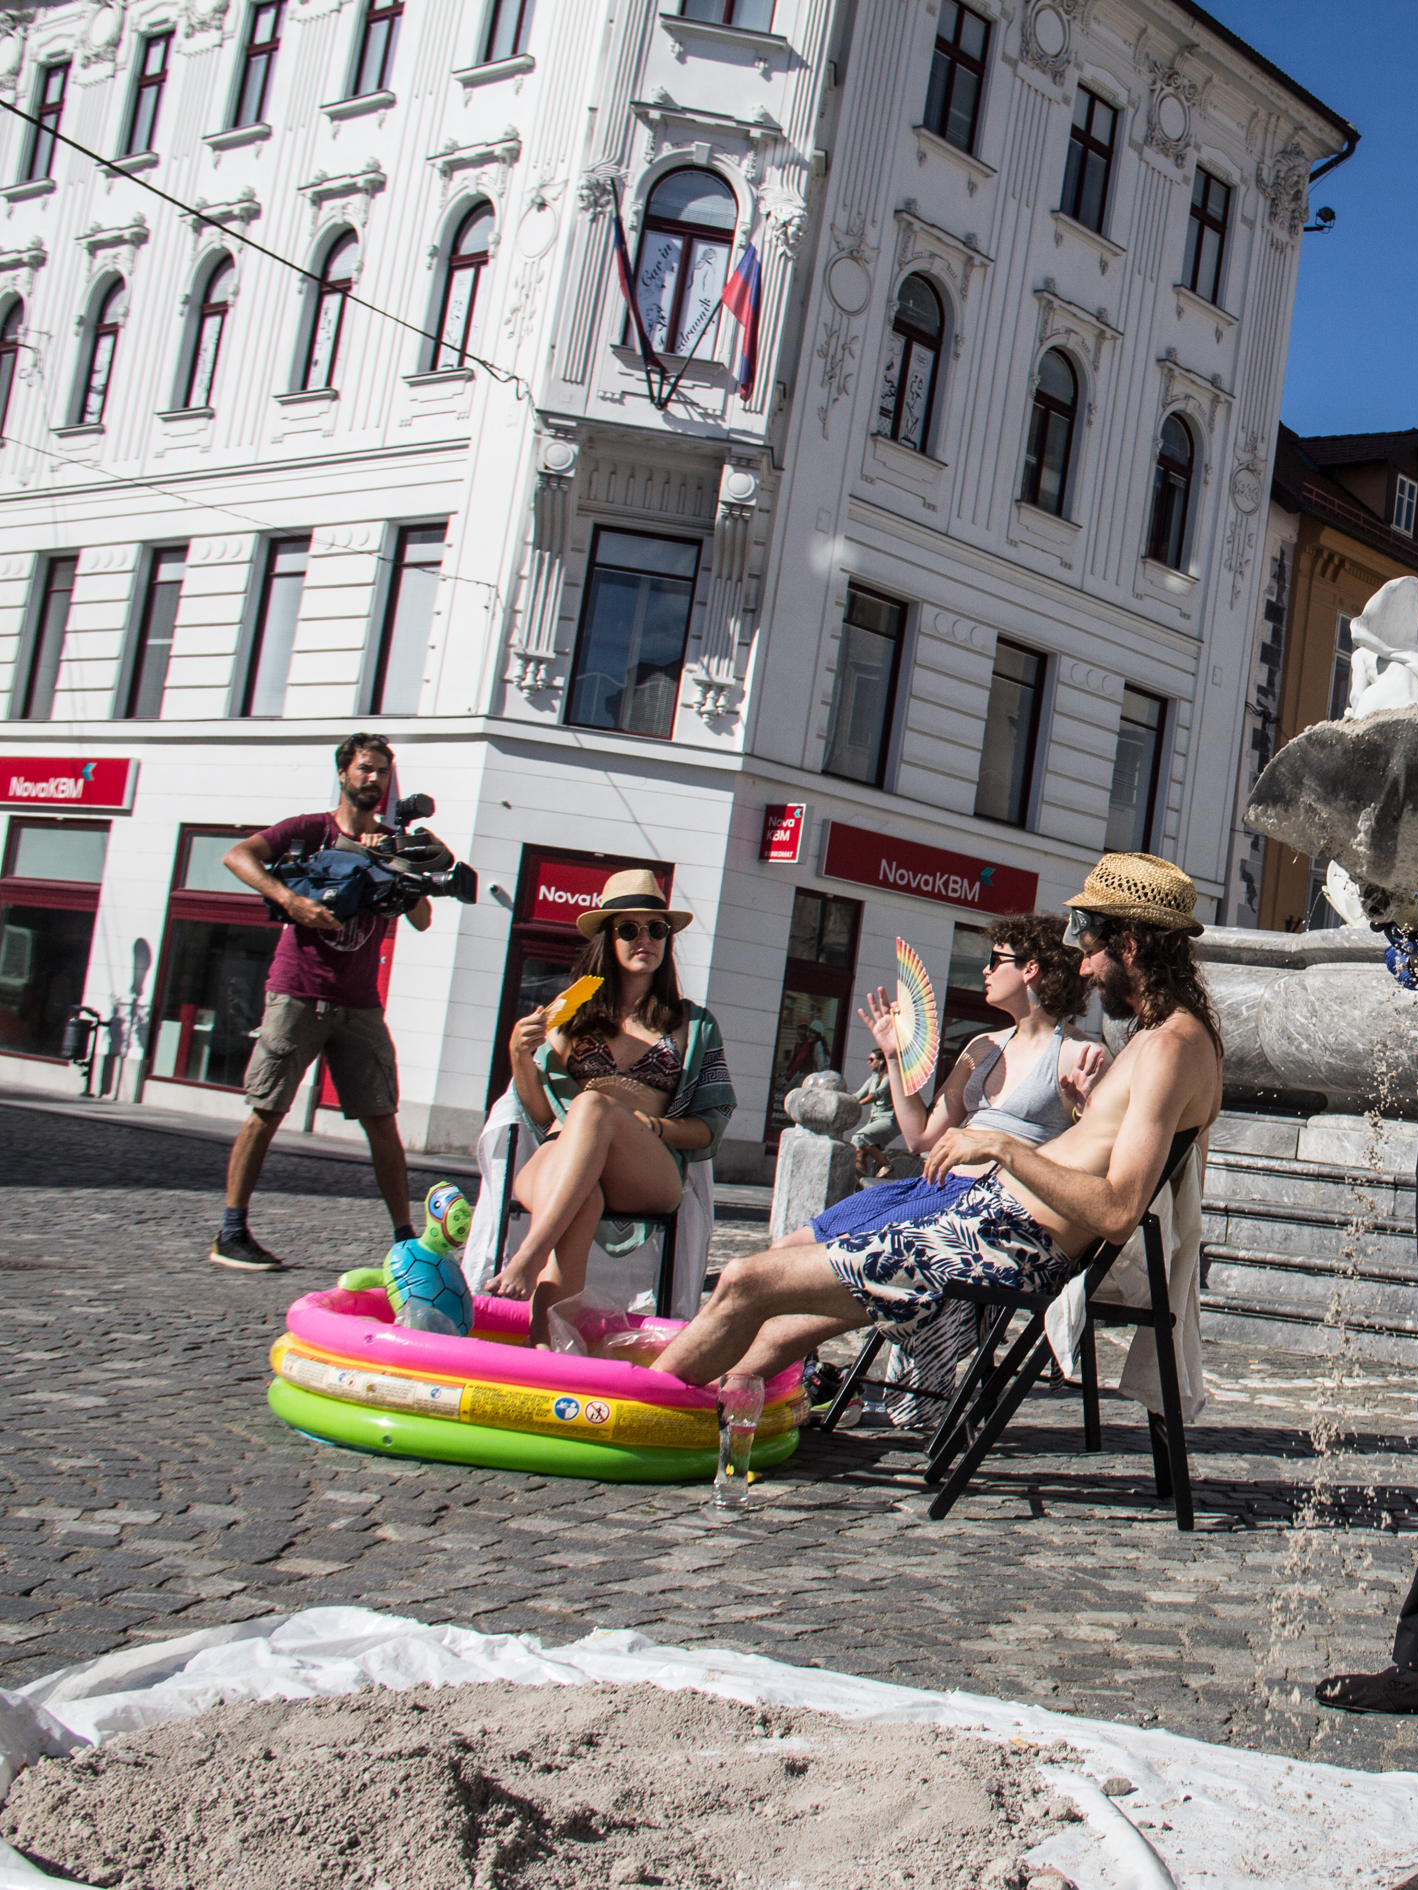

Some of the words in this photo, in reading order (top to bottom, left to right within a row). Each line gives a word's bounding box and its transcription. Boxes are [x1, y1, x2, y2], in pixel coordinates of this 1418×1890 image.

[8, 776, 85, 799] NovaKBM
[768, 816, 795, 828] Nova
[766, 829, 791, 841] KBM
[879, 858, 981, 902] NovaKBM
[538, 885, 605, 908] NovaK
